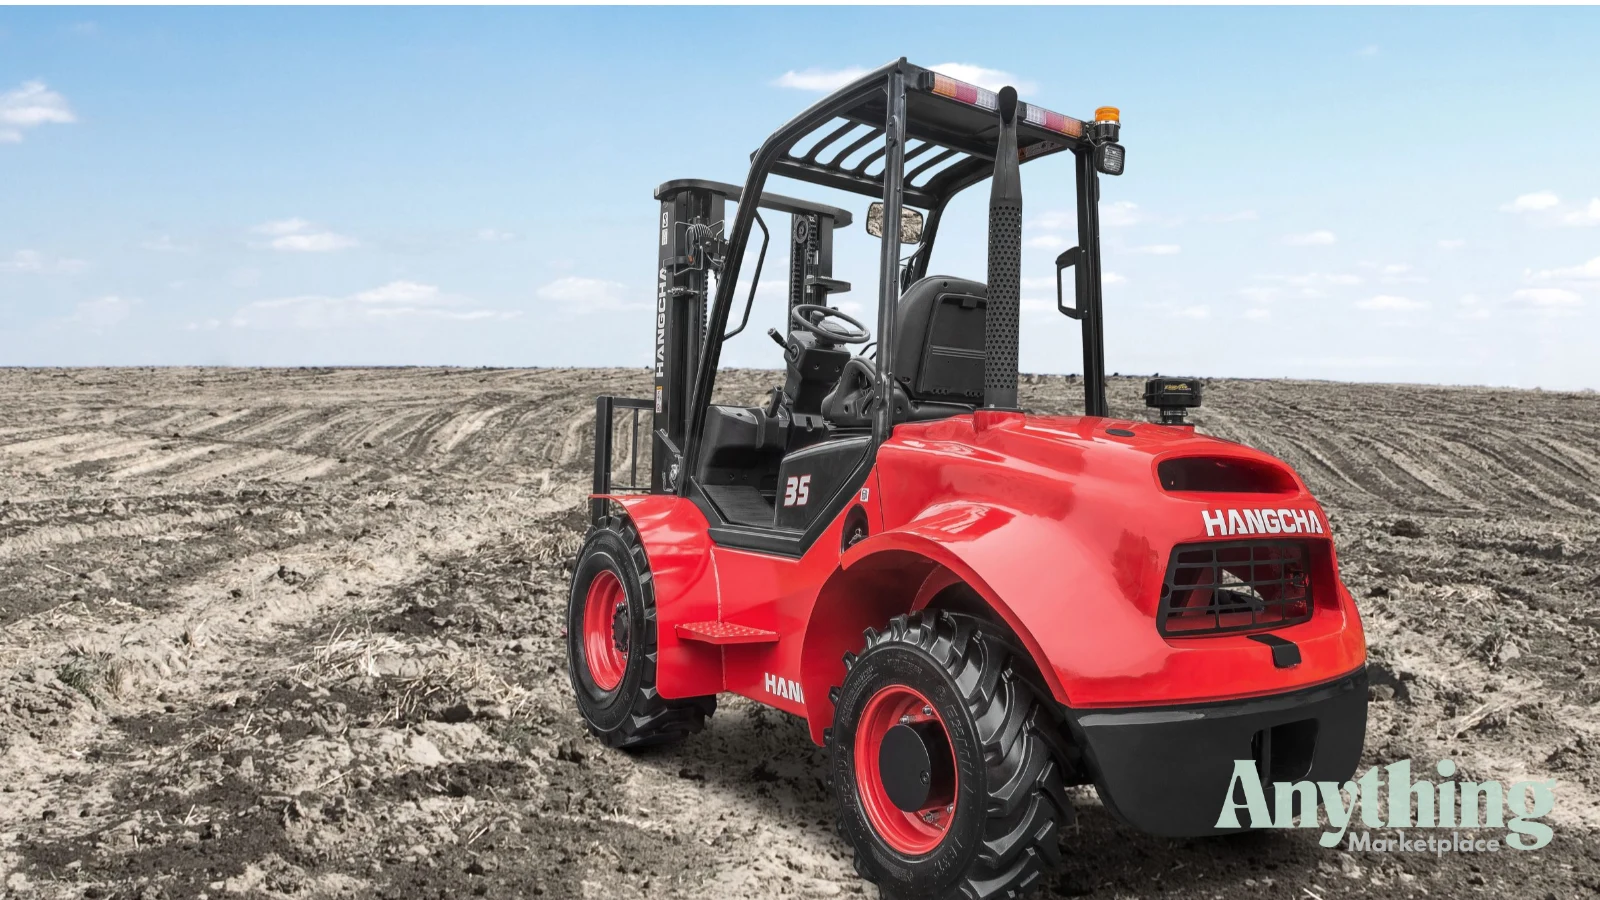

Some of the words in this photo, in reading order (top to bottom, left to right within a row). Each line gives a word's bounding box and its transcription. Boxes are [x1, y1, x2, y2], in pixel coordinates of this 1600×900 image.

[656, 266, 667, 378] HANGCHA
[784, 474, 811, 507] 35
[1201, 508, 1323, 537] HANGCHA
[764, 672, 805, 704] HAN
